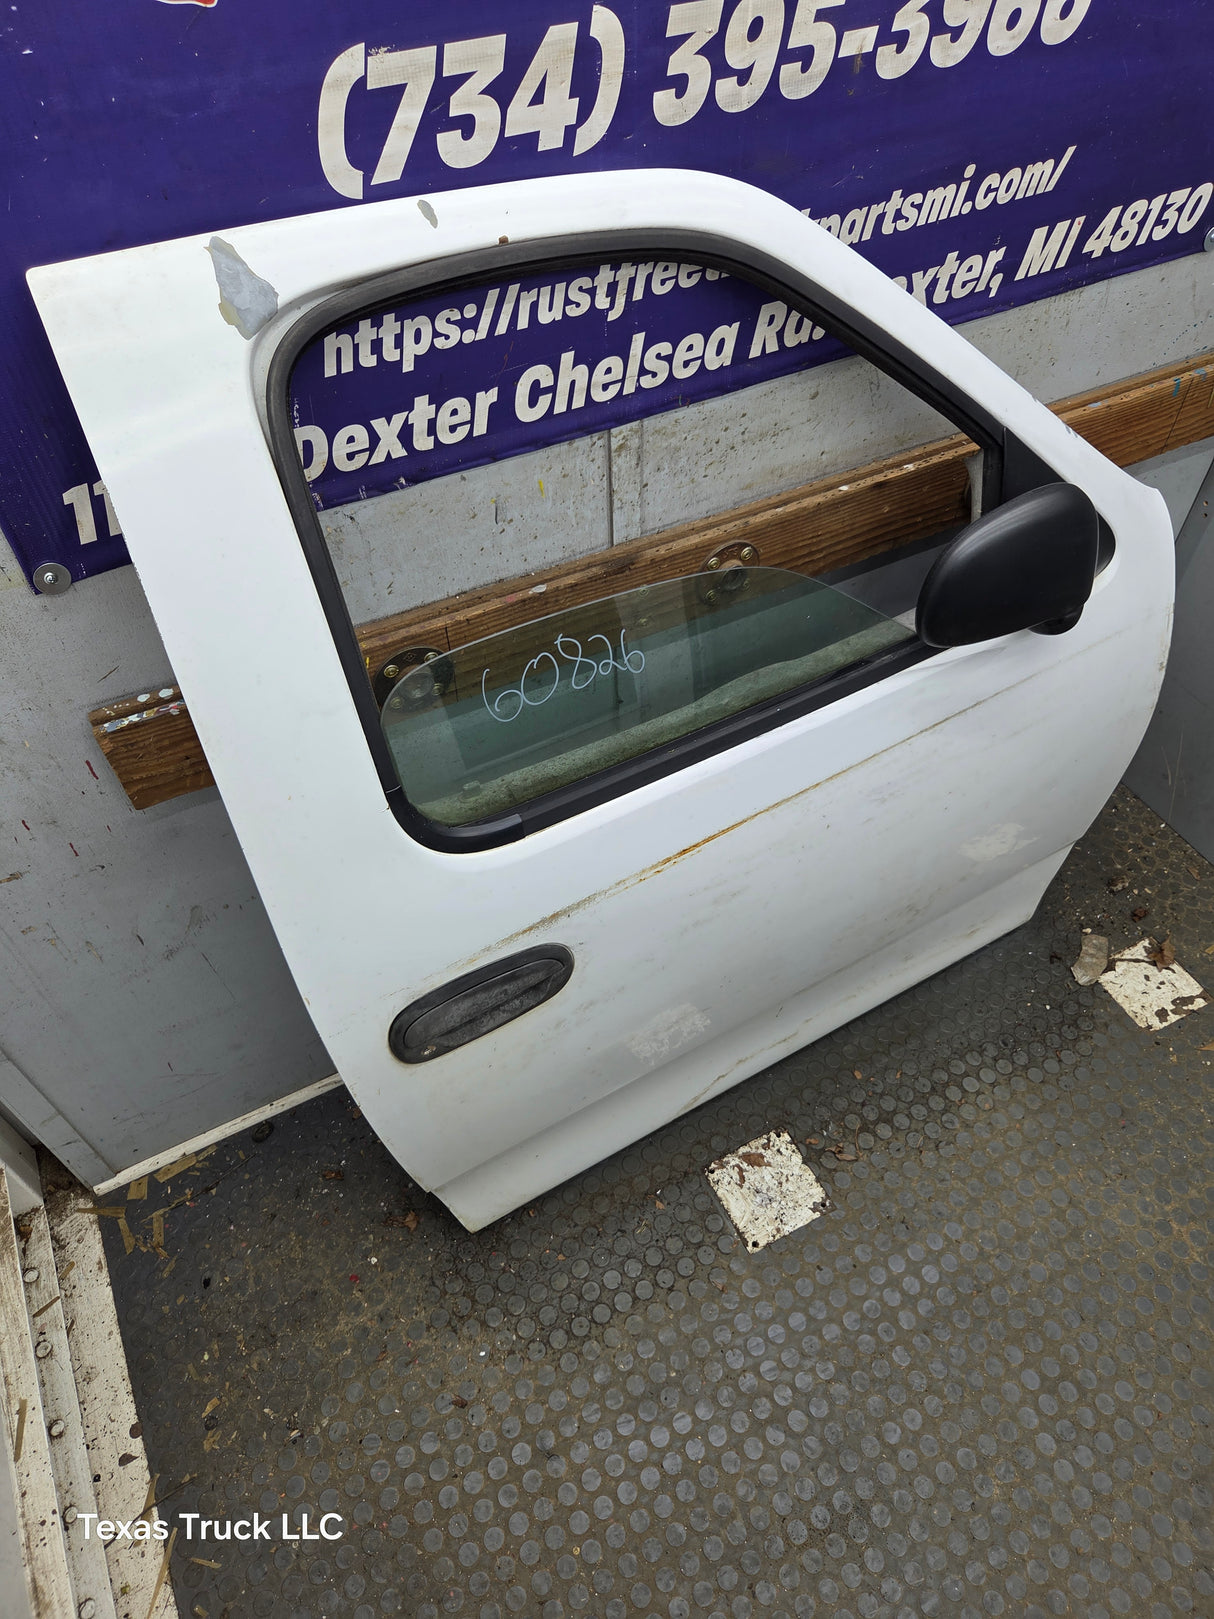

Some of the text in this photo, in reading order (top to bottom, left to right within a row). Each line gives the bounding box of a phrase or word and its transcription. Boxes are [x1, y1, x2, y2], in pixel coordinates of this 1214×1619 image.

[317, 4, 626, 200] (734)
[293, 386, 499, 483] Dexter
[515, 321, 741, 423] Chelsea
[892, 245, 1007, 308] xter,
[1014, 215, 1087, 282] MI
[1081, 182, 1214, 259] 48130
[481, 628, 646, 722] 60826
